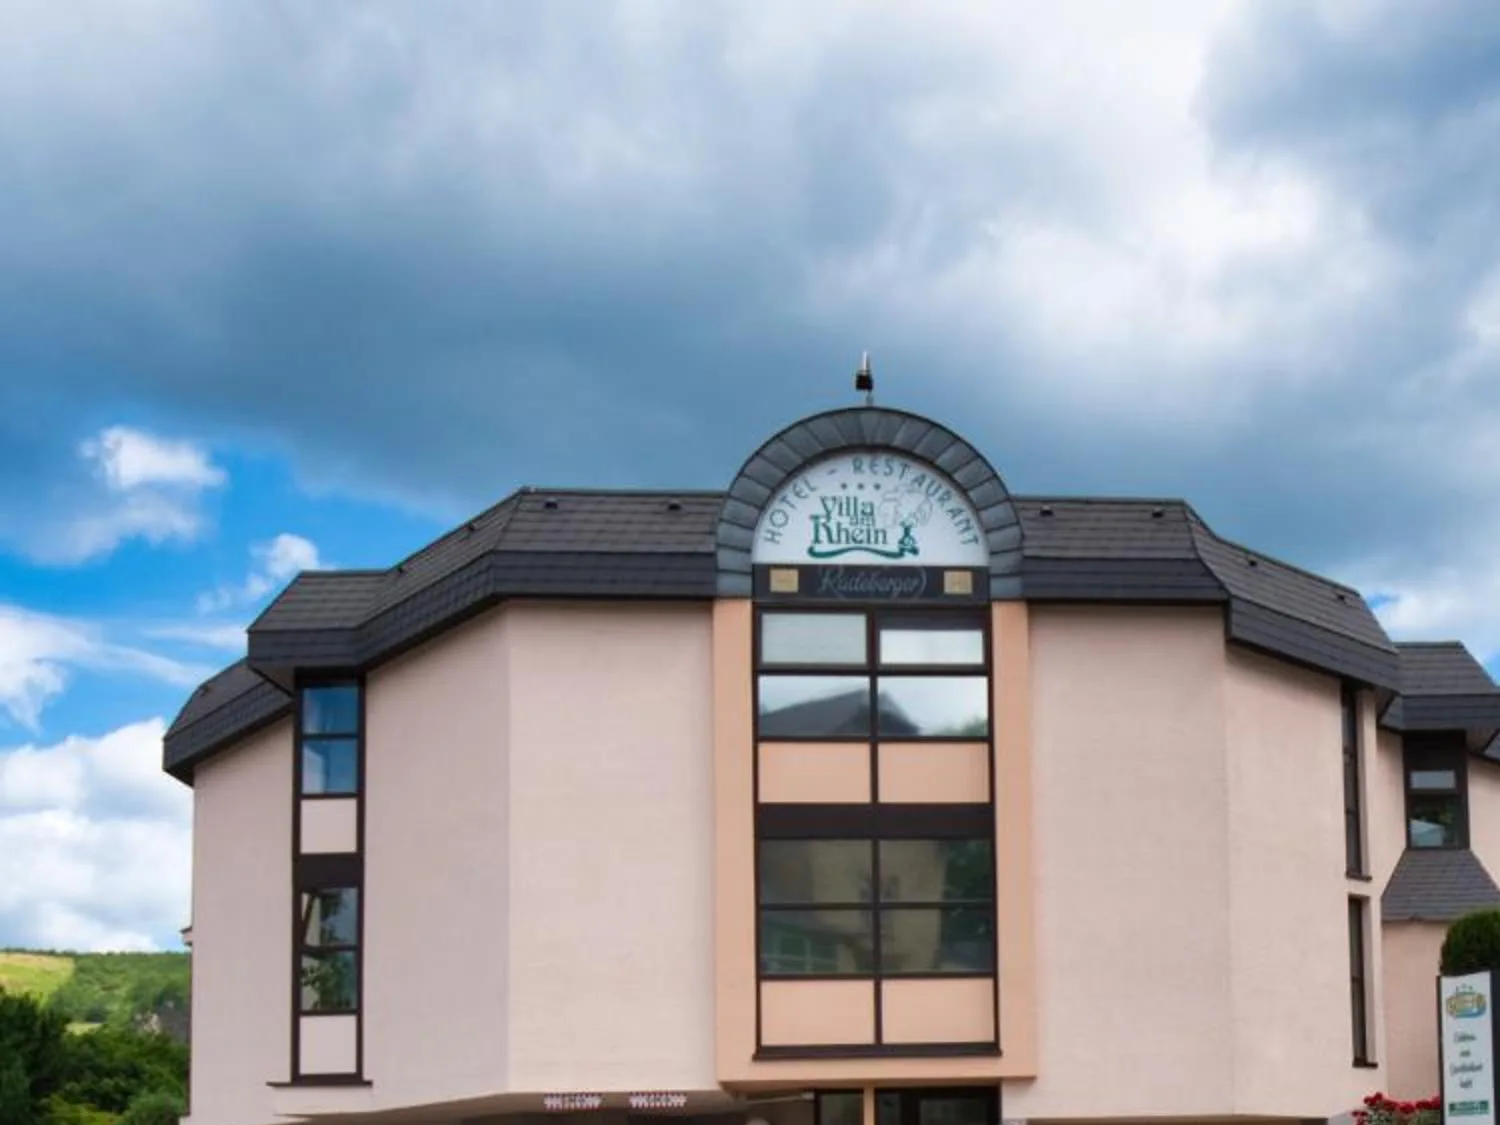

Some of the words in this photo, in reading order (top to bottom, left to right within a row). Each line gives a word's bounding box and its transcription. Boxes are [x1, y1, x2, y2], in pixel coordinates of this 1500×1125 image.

[764, 477, 817, 544] HOTEL
[853, 455, 979, 545] RESTAURANT
[819, 495, 875, 523] Villa
[810, 514, 888, 545] Rhein
